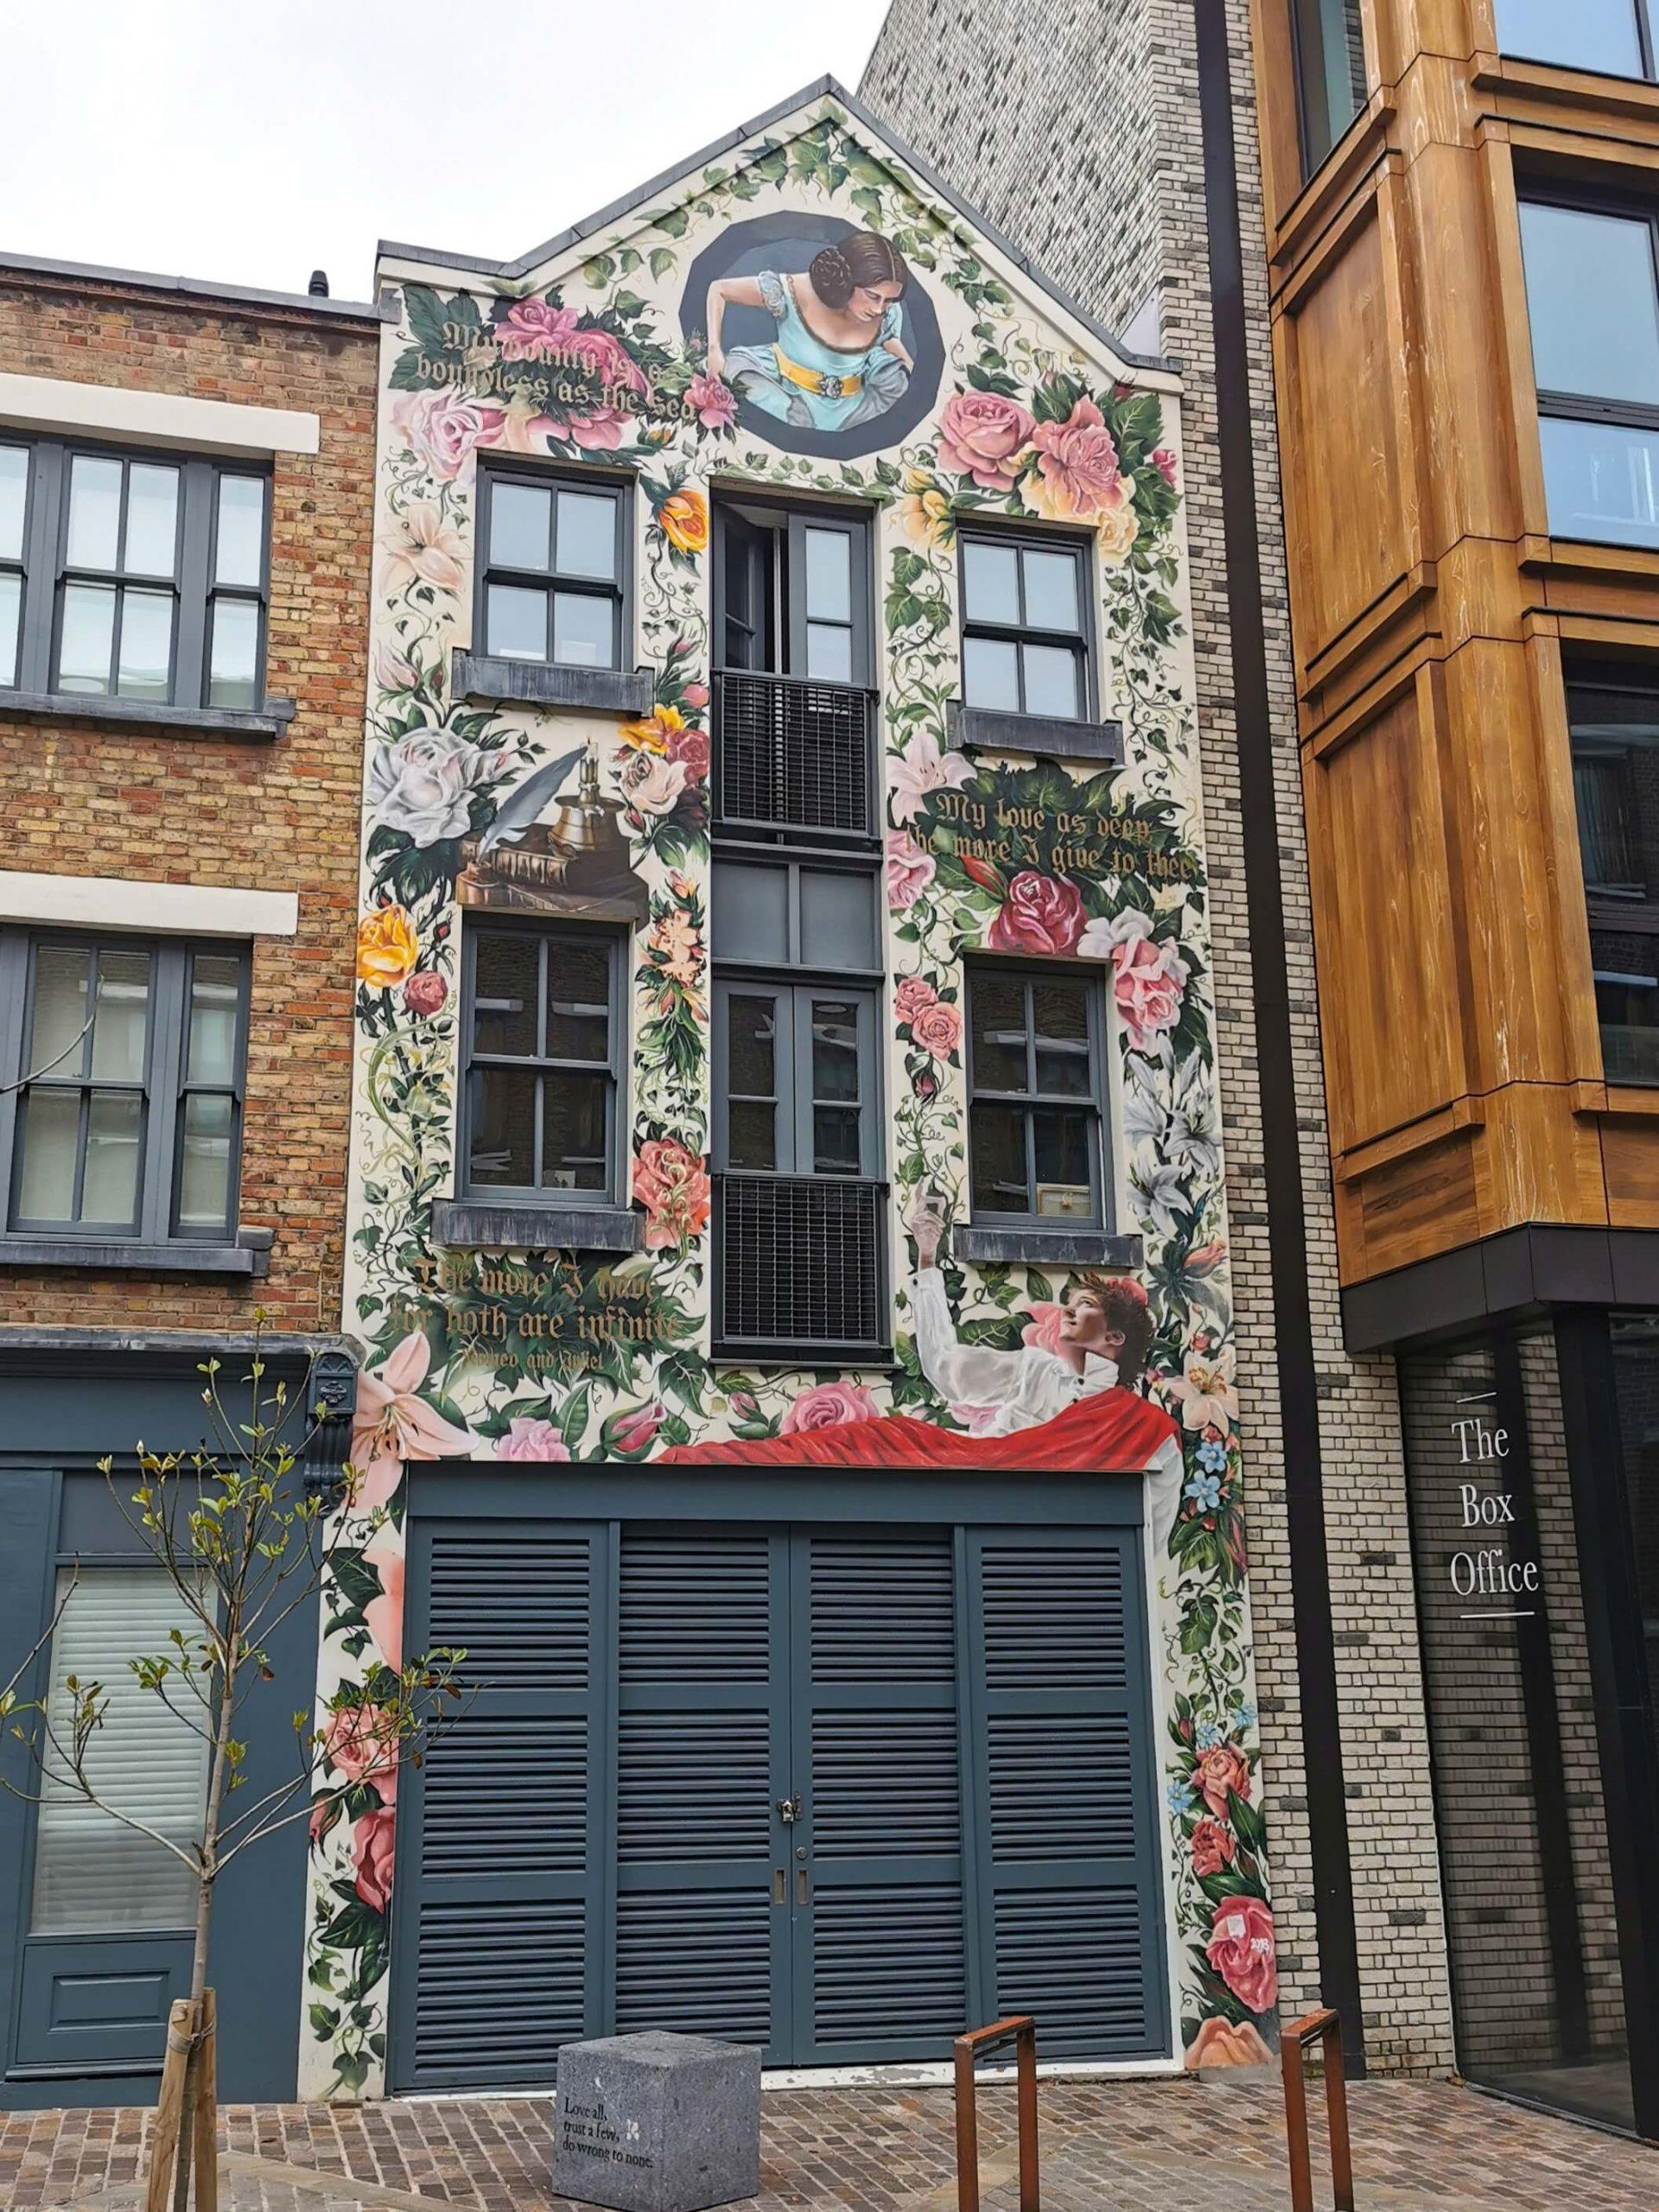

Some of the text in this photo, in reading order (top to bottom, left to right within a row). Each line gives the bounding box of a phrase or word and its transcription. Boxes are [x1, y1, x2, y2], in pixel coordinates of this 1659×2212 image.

[508, 334, 596, 378] bounty
[415, 351, 697, 420] boundless as the sea
[936, 793, 986, 830] My
[996, 798, 1046, 830] love
[1057, 813, 1086, 835] as
[904, 823, 939, 855] the
[953, 836, 1011, 862] more
[1052, 840, 1100, 874] give
[1111, 846, 1135, 874] to
[1147, 849, 1192, 880] thee
[413, 1257, 473, 1295] The
[480, 1268, 550, 1297] more
[391, 1298, 680, 1344] for both are infinite
[527, 1350, 555, 1370] and
[1452, 1418, 1510, 1463] The
[1459, 1484, 1516, 1527] Box
[1450, 1548, 1539, 1596] Office
[563, 2096, 607, 2121] Love all,
[563, 2120, 620, 2143] trust a few,
[563, 2134, 653, 2169] do wrong to none.
